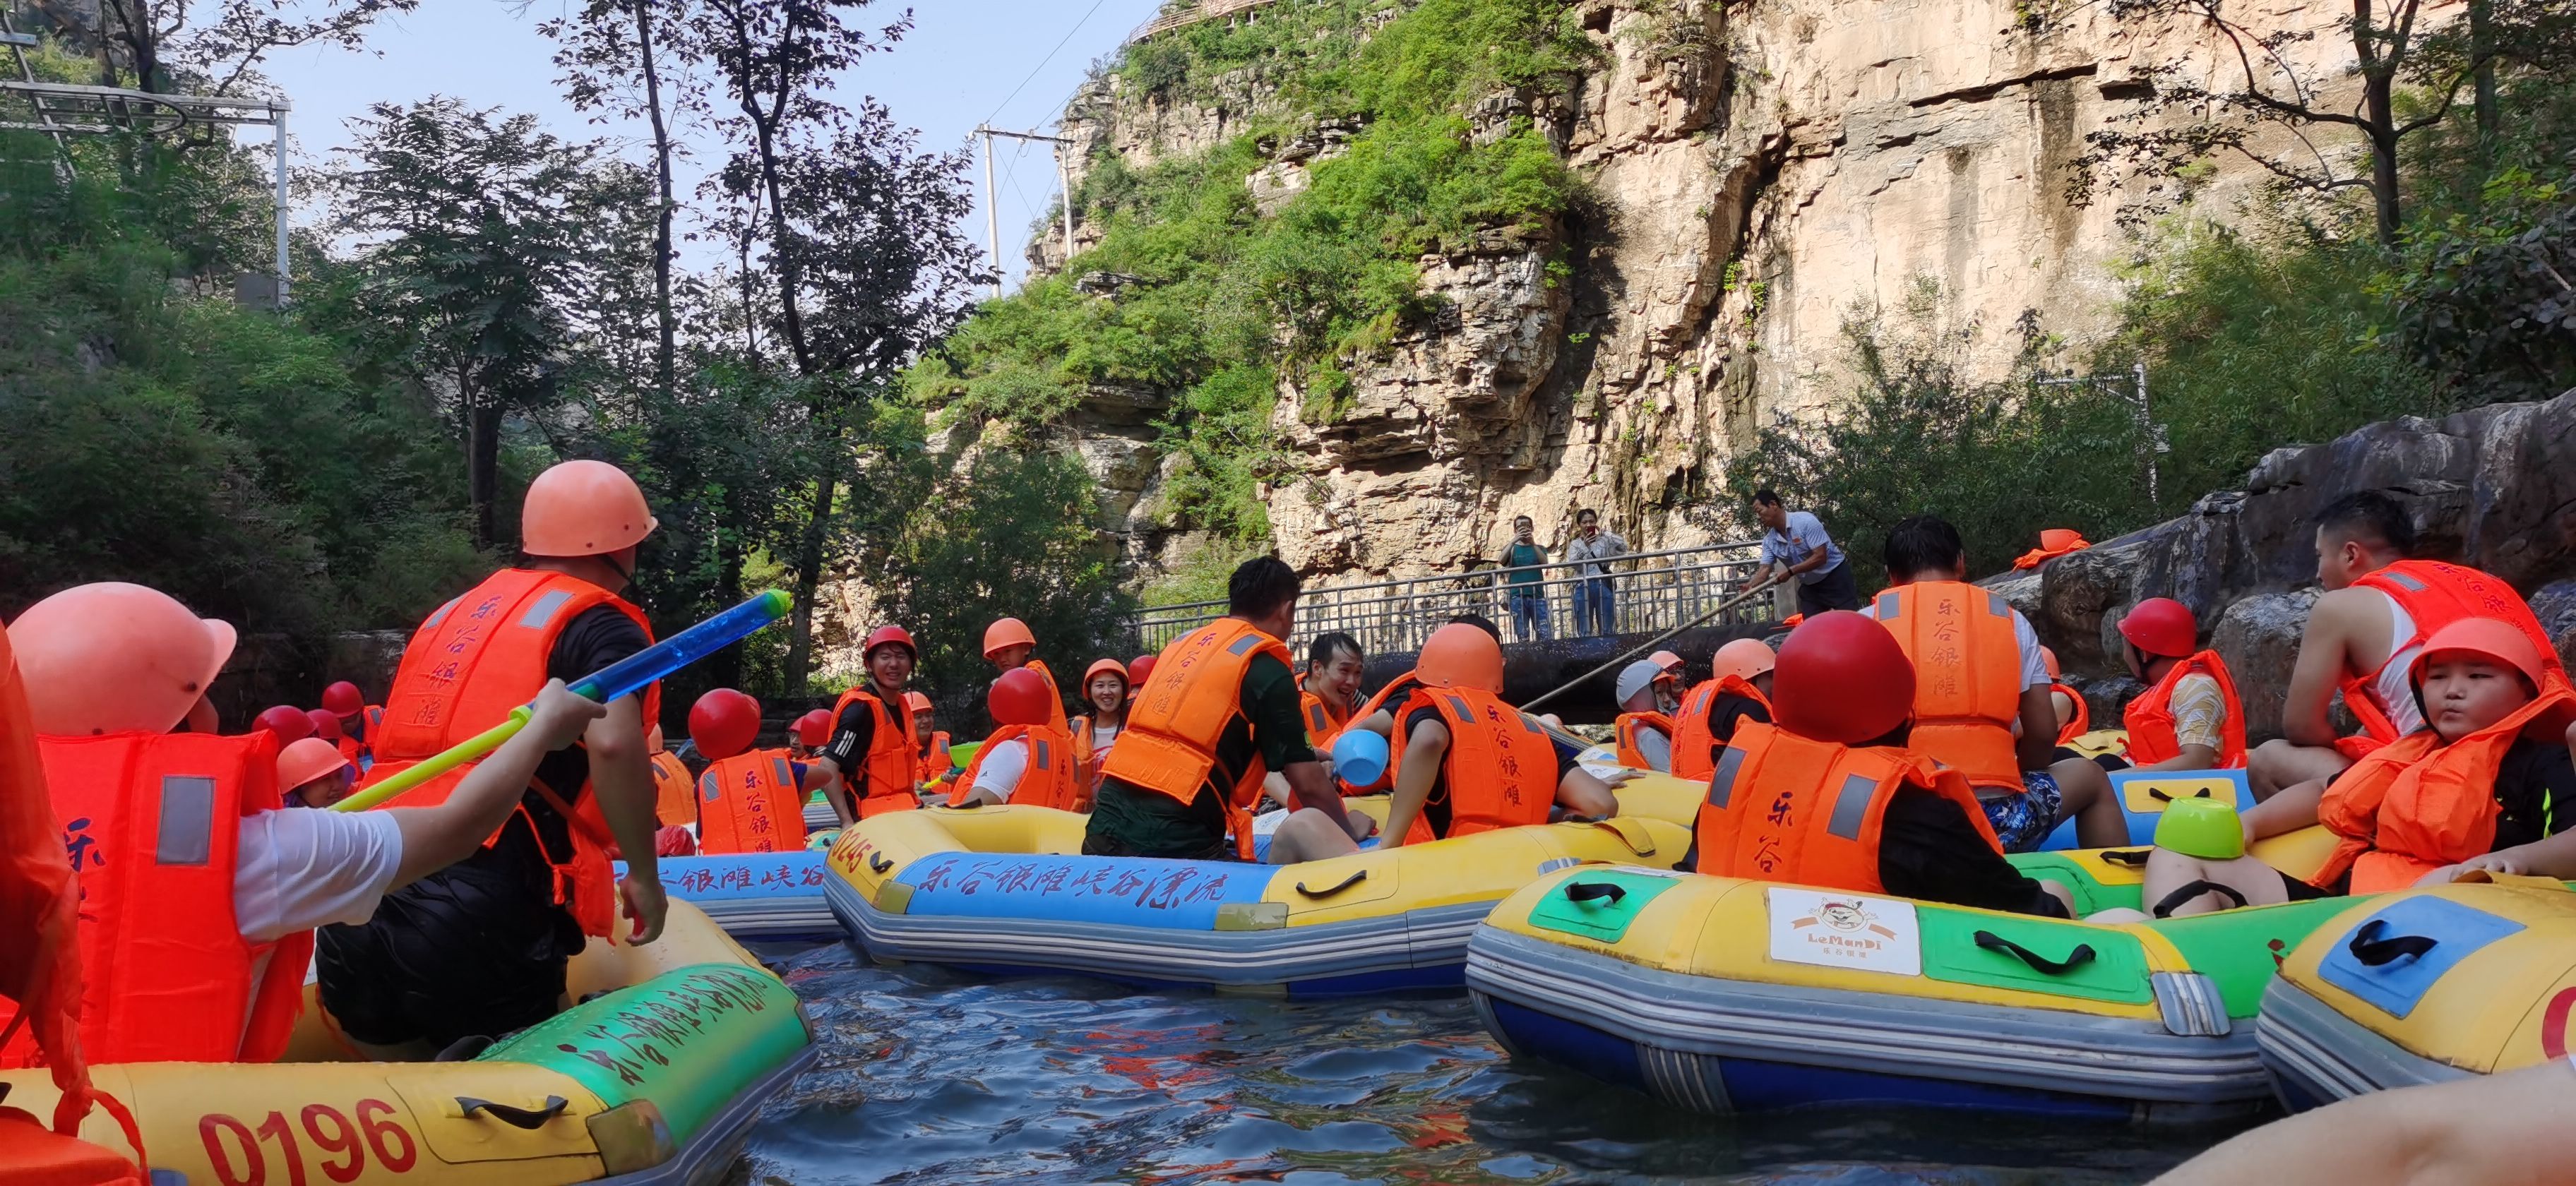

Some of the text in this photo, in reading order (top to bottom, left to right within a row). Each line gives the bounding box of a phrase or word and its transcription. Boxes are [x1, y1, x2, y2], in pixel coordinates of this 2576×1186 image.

[1931, 599, 1961, 699] 乐谷银滩
[1486, 705, 1522, 808] 乐谷银滩
[1754, 791, 1793, 873] 乐谷
[613, 863, 824, 893] 银滩峡谷
[919, 858, 1229, 909] 乐谷银滩峡谷漂流
[1808, 933, 1882, 950] LeManDi
[198, 1098, 417, 1186] 0196
